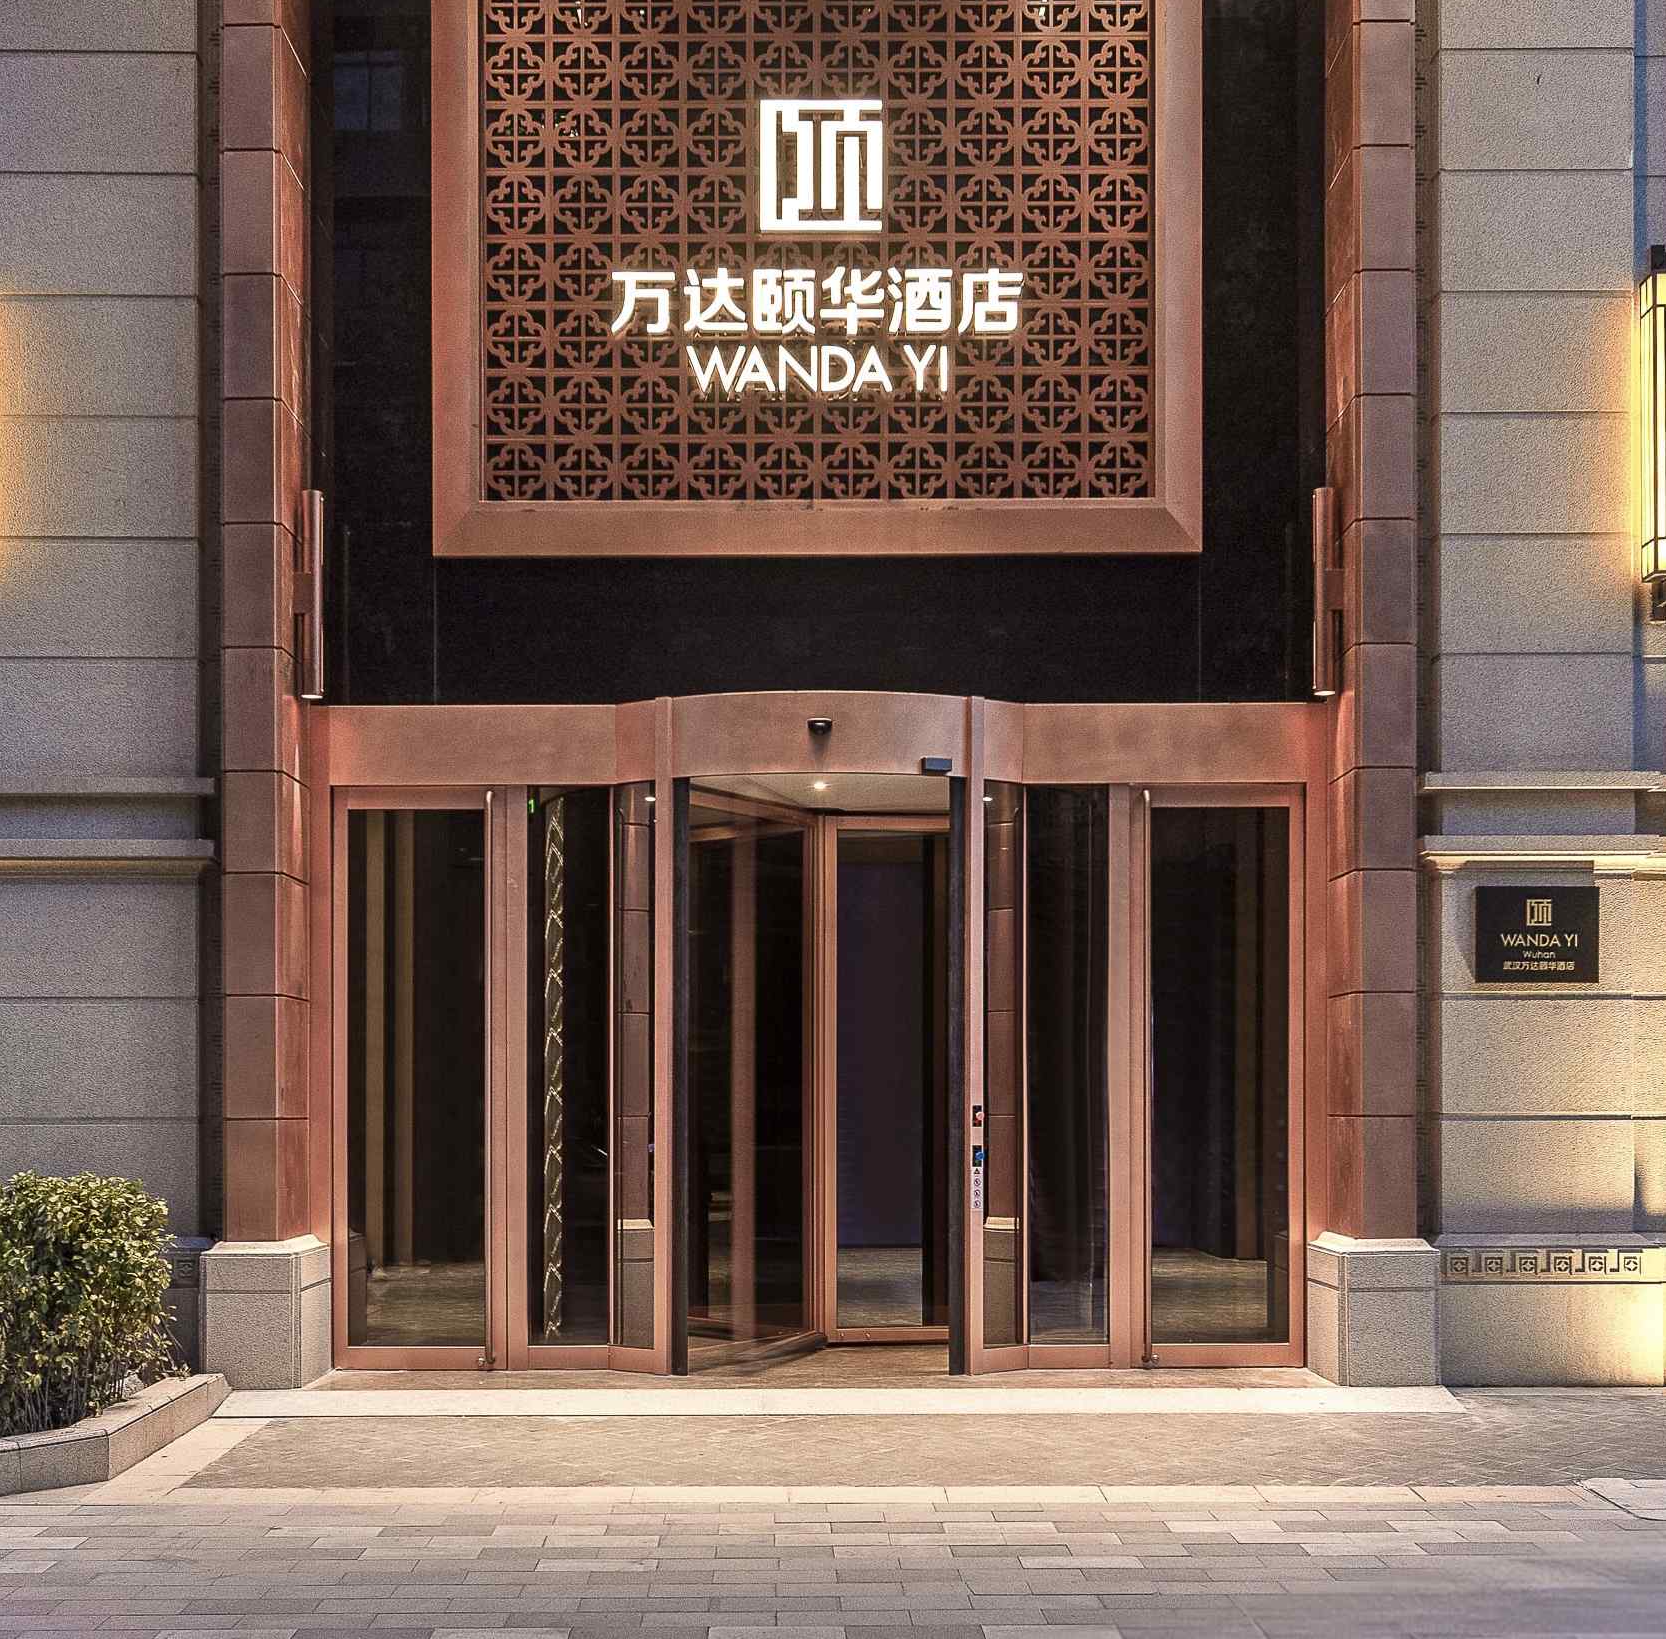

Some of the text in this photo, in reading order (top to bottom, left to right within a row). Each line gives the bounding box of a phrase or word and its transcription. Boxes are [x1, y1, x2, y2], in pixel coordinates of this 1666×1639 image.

[610, 266, 1024, 336] 万达颐华酒店
[685, 344, 949, 393] WANDA YI
[1500, 933, 1578, 948] WANDA YI
